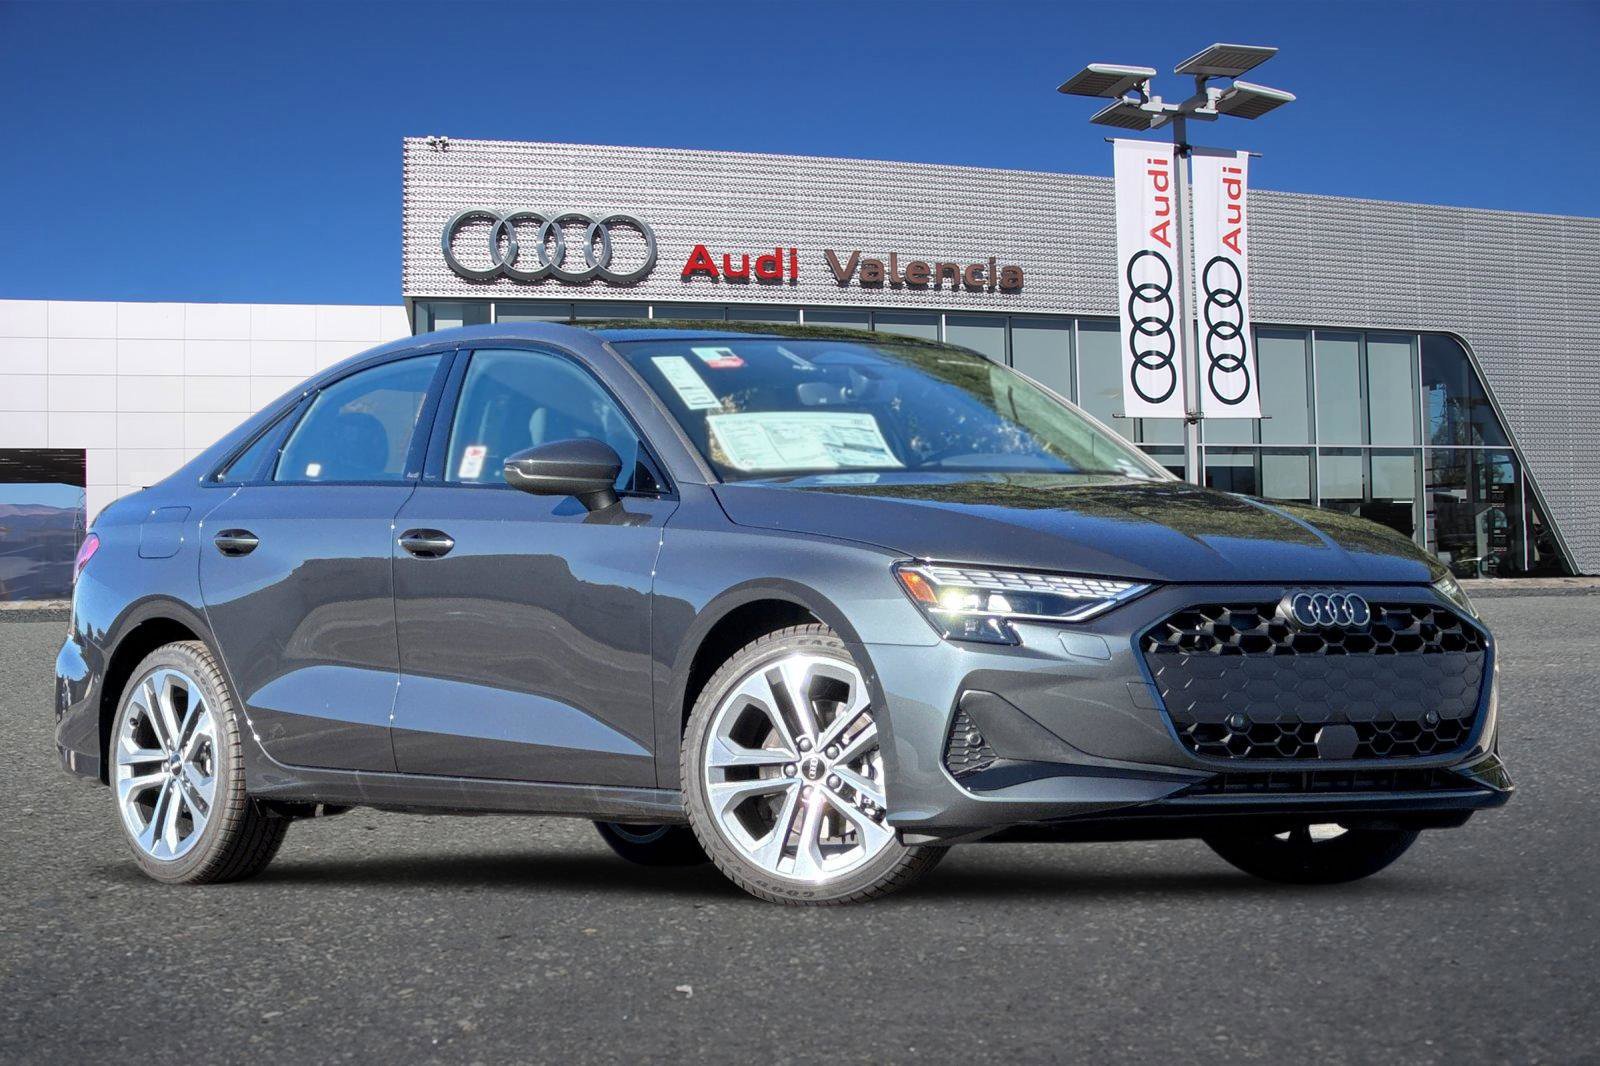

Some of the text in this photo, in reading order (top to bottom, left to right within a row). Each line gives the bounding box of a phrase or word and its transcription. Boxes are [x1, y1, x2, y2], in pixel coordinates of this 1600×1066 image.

[1147, 158, 1172, 248] Audi
[1222, 166, 1243, 255] Audi
[681, 244, 1024, 292] Audi Valencia
